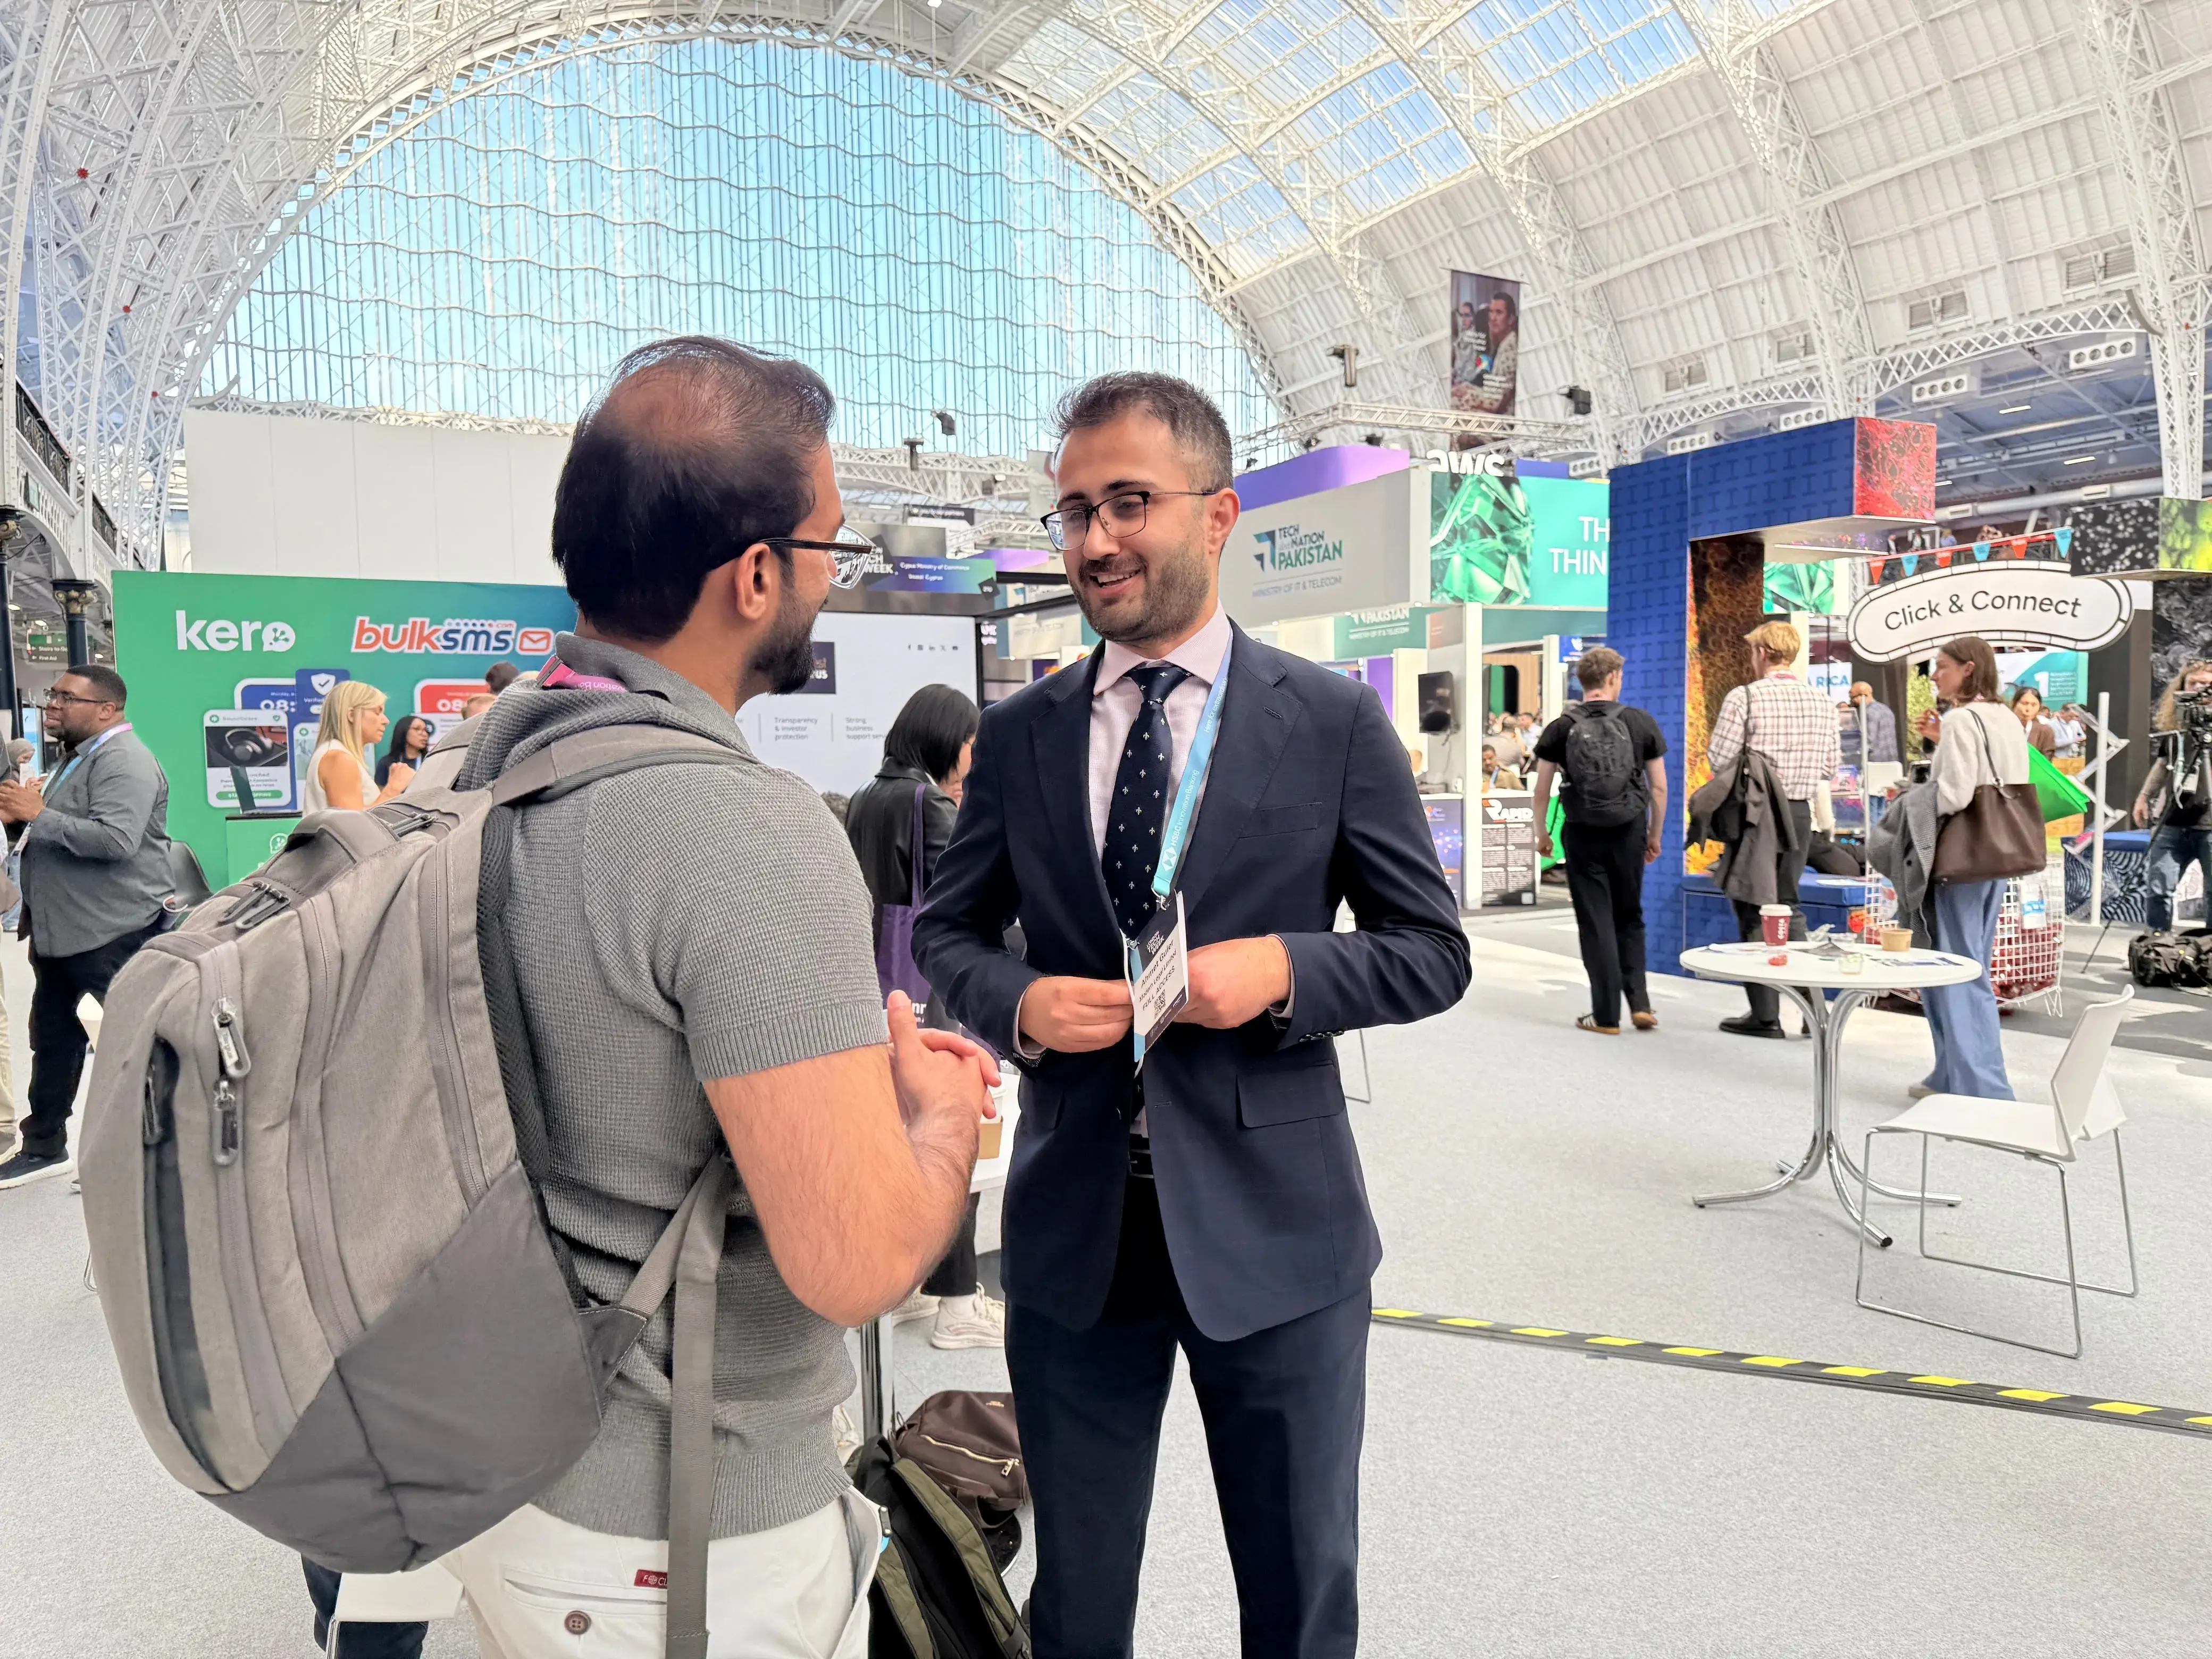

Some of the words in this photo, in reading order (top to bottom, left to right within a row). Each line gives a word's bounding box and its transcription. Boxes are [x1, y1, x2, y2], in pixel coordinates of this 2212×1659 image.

[1279, 524, 1299, 539] TECH
[865, 564, 894, 574] WEEK
[1278, 539, 1342, 571] PAKISTAN
[1308, 576, 1342, 589] TELECOM
[1884, 599, 1941, 630] Click
[1948, 594, 1964, 613] &
[1971, 590, 2082, 617] Connect
[176, 610, 296, 652] kero
[353, 617, 514, 653] bulksms
[1171, 823, 1182, 846] HSBC
[1177, 792, 1191, 827] Innovation
[1185, 769, 1200, 794] Banking
[1147, 934, 1161, 952] TECH
[1152, 935, 1164, 954] WEEK
[1141, 960, 1159, 988] Ahmet
[1143, 993, 1155, 1011] FULL
[1156, 966, 1175, 995] ACCESS
